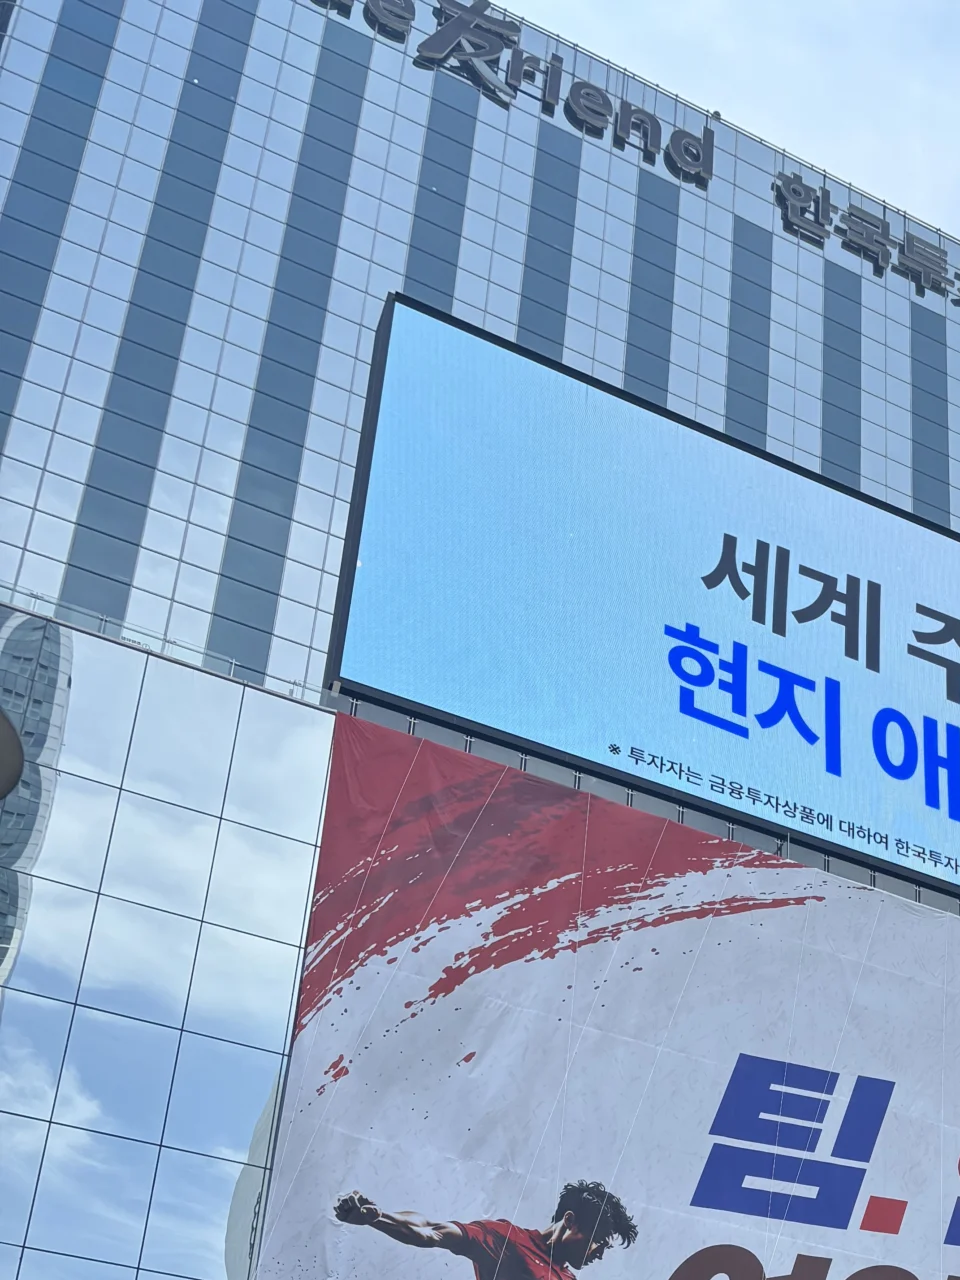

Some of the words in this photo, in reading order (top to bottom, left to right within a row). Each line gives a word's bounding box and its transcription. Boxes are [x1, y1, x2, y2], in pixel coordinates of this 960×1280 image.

[701, 532, 882, 673] 세계
[664, 622, 842, 778] 현지
[627, 746, 703, 786] 투자자는
[708, 773, 833, 832] 금융투자상품에
[839, 820, 889, 850] 대하여
[690, 1051, 909, 1235] 팀.
